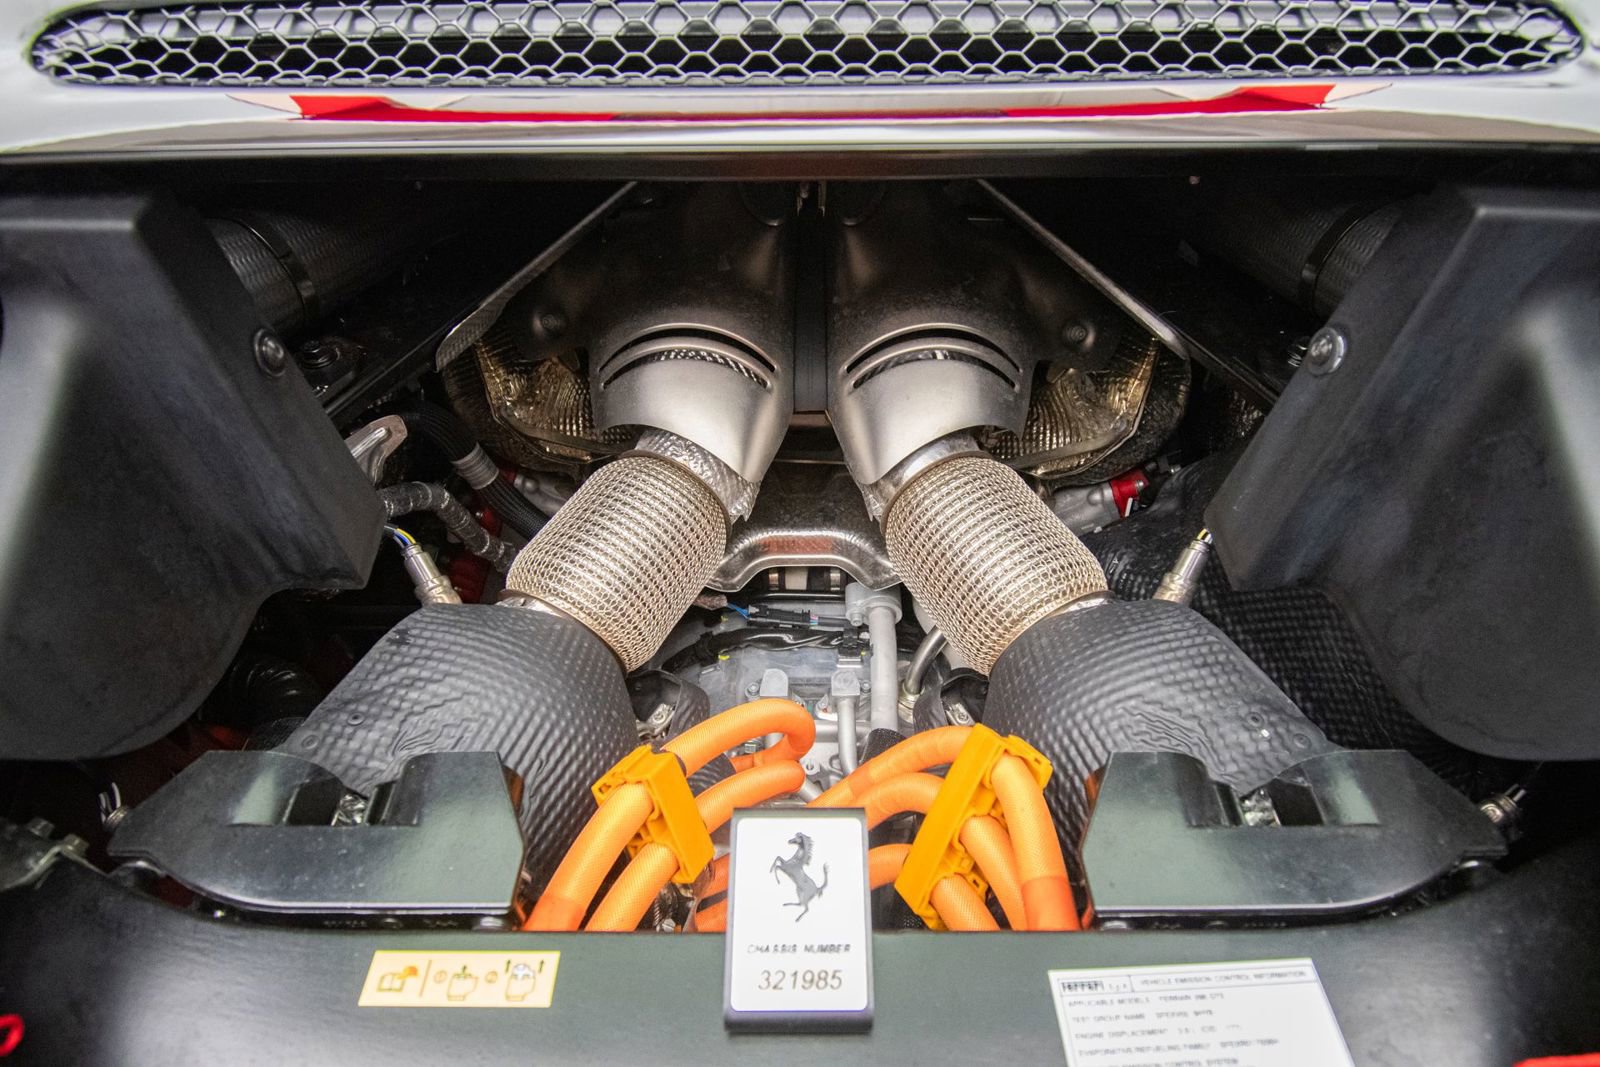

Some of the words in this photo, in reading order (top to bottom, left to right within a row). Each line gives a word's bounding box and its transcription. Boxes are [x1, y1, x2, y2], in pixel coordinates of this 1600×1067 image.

[747, 944, 797, 953] CHASSIS
[804, 943, 850, 953] NUMBER
[758, 969, 843, 990] 321985
